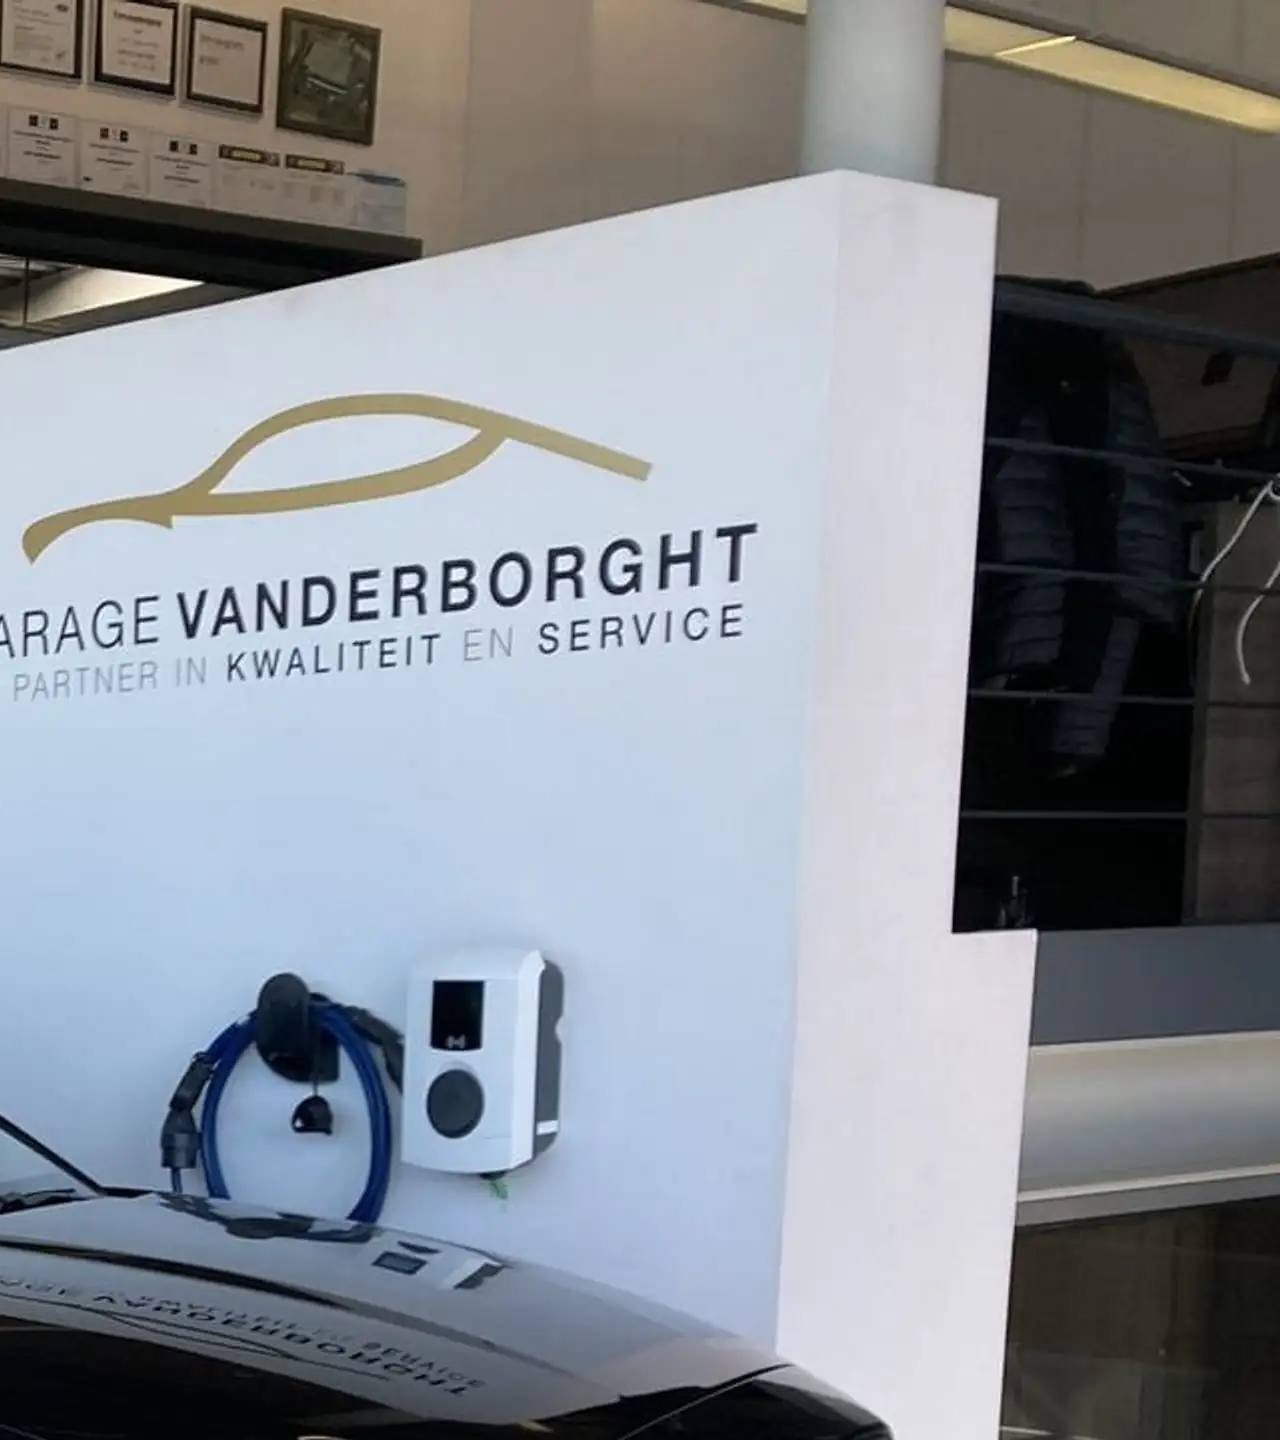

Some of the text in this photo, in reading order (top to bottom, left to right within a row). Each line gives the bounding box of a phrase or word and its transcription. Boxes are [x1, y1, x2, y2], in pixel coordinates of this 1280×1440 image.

[176, 523, 758, 640] VANDERBORGHT
[13, 660, 159, 702] PARTNER
[176, 656, 207, 687] IN
[226, 633, 441, 683] KWALITEIT
[463, 626, 514, 662] EN
[538, 603, 744, 655] SERVICE
